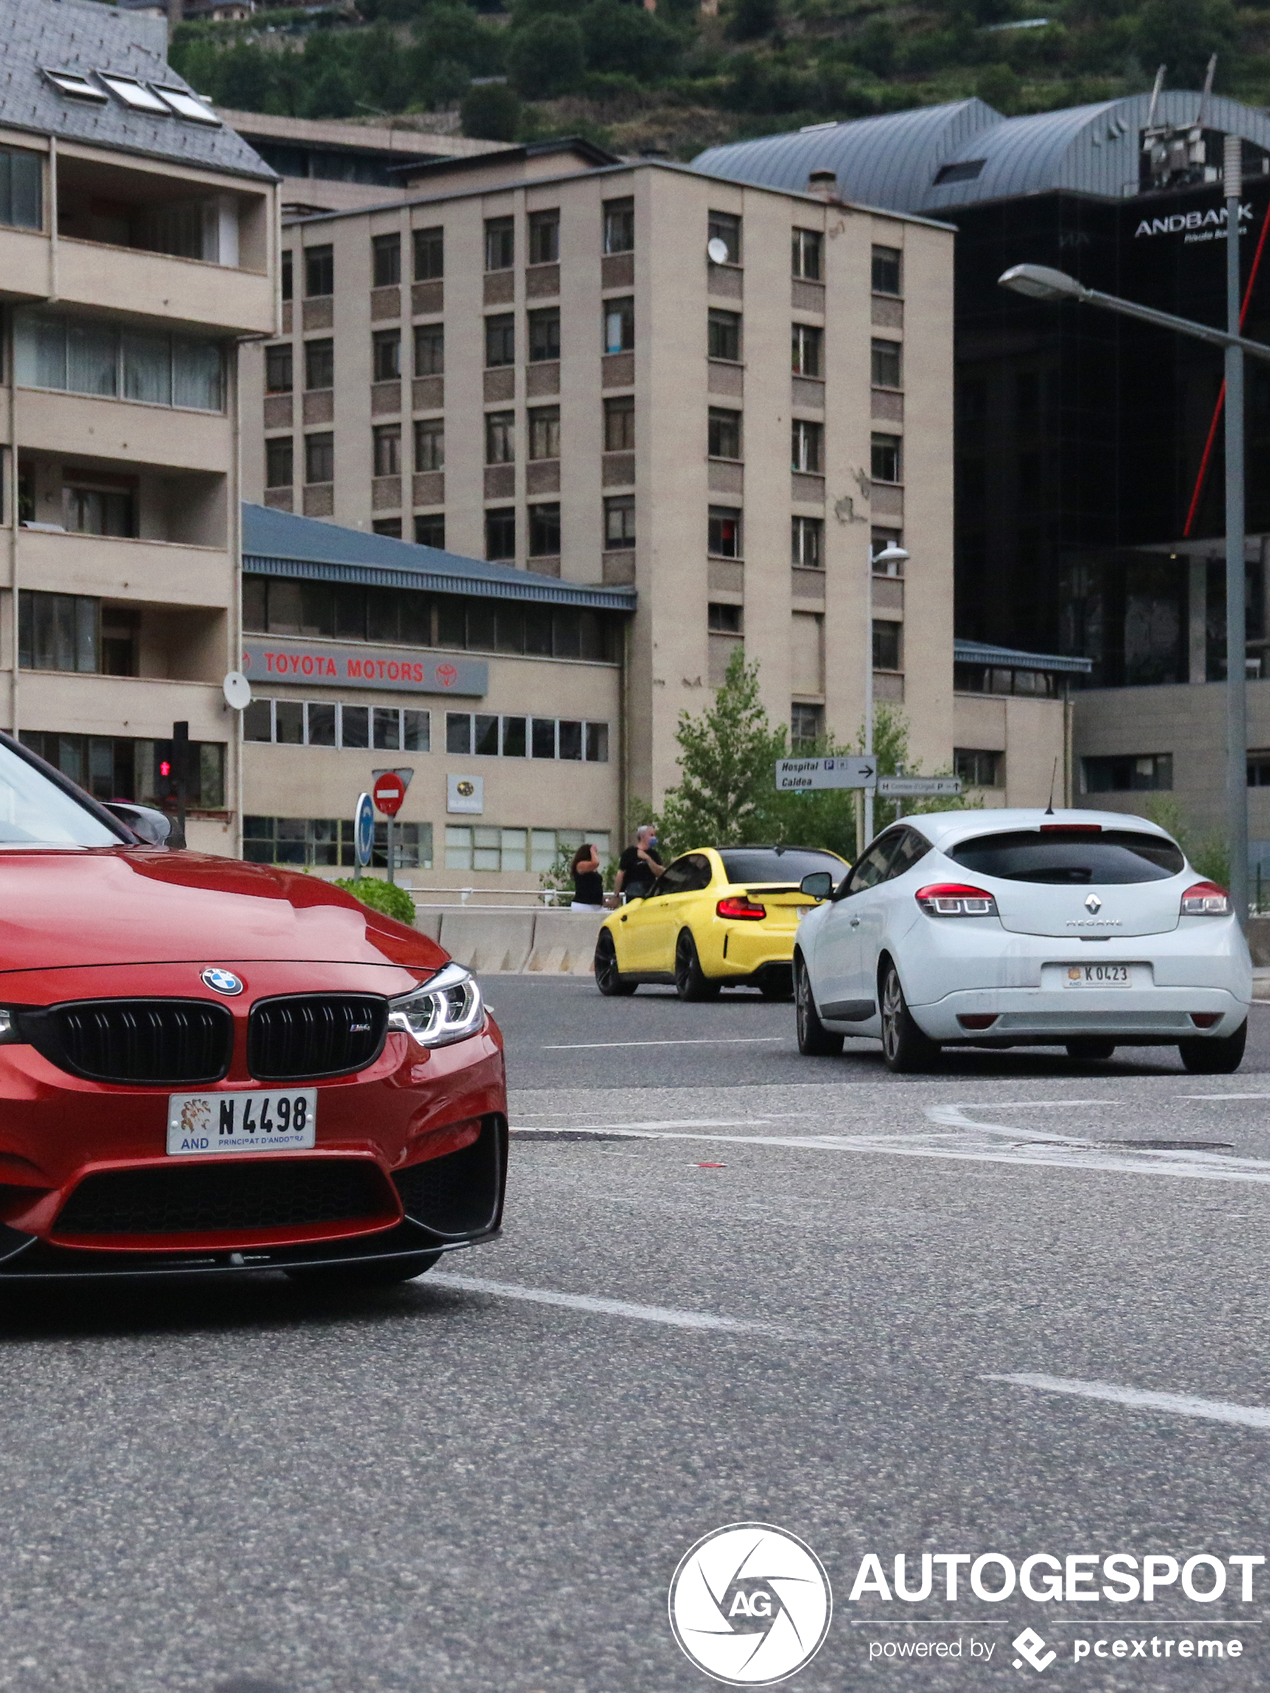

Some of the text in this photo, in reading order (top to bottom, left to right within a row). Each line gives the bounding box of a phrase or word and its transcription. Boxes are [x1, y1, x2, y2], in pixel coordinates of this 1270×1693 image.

[265, 653, 424, 683] TOYOTA MOTORS
[781, 761, 819, 772] Hospital
[782, 778, 813, 788] Caldea
[1085, 967, 1128, 981] K 0423
[219, 1097, 307, 1135] N 4498
[181, 1137, 209, 1149] AND
